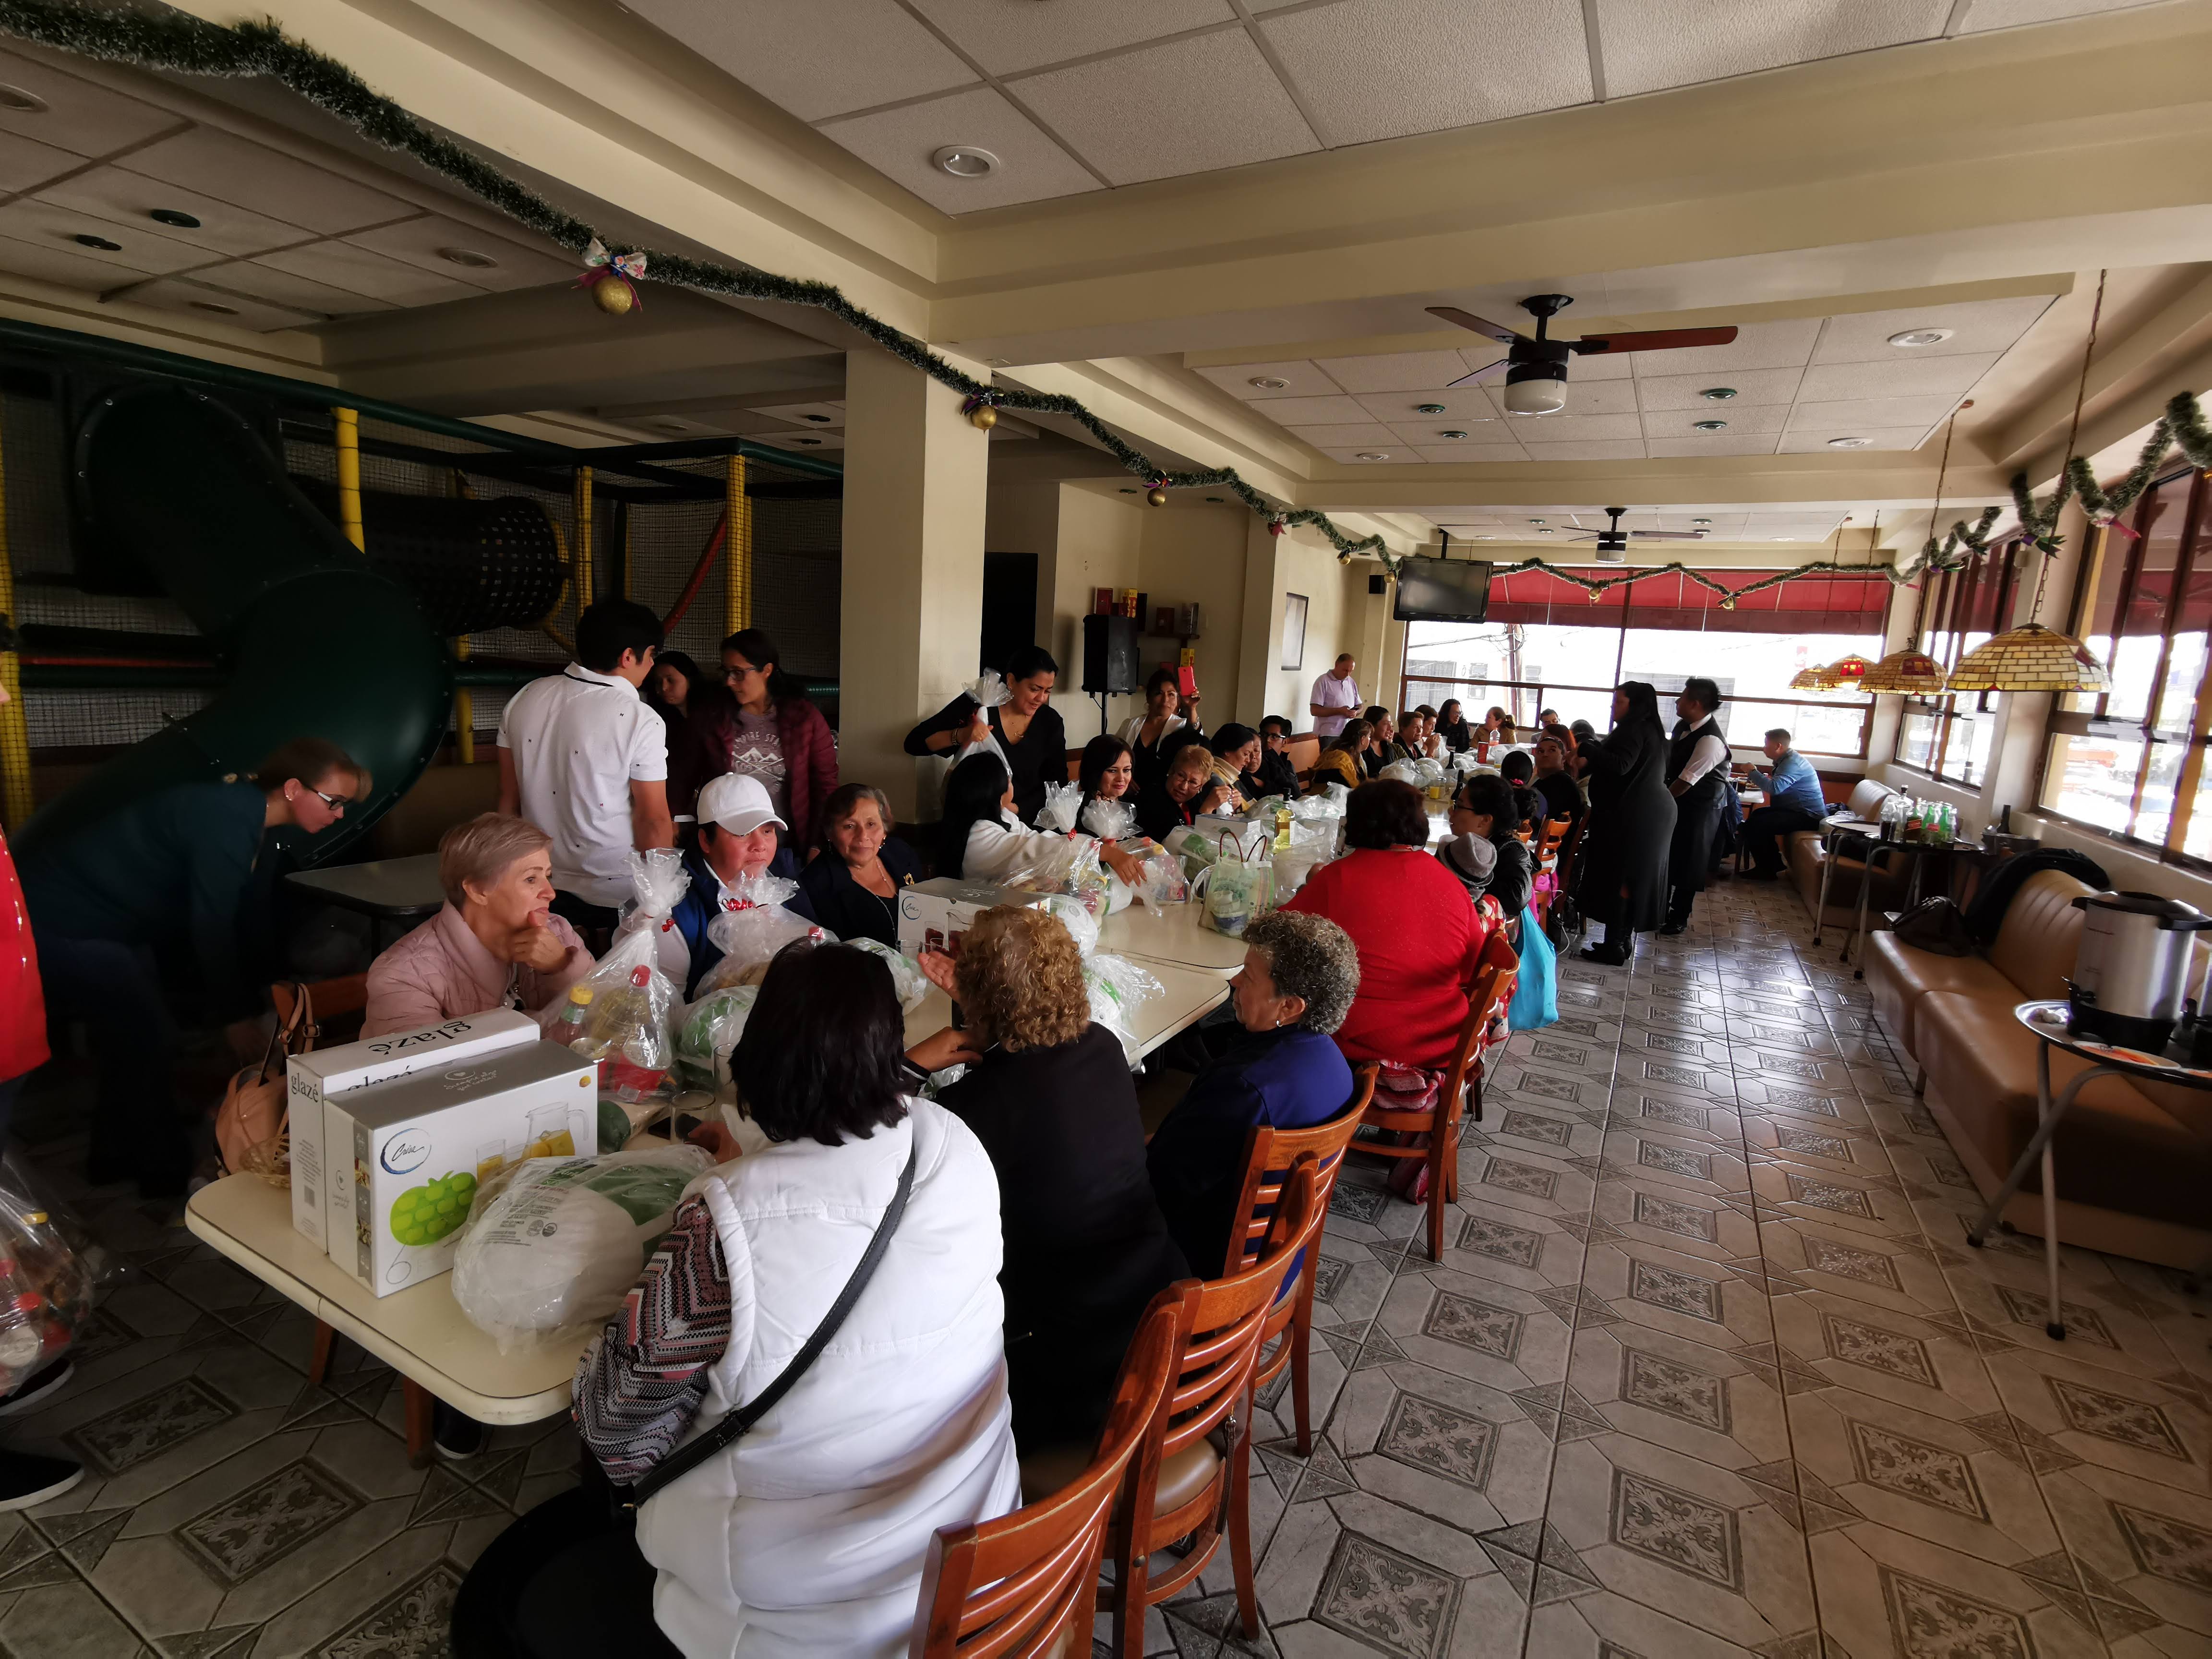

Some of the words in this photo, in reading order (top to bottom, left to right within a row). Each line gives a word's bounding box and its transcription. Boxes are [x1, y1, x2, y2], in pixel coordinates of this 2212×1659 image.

[368, 1021, 472, 1055] glazé
[291, 1072, 319, 1103] glazé
[392, 1143, 425, 1161] Crisa
